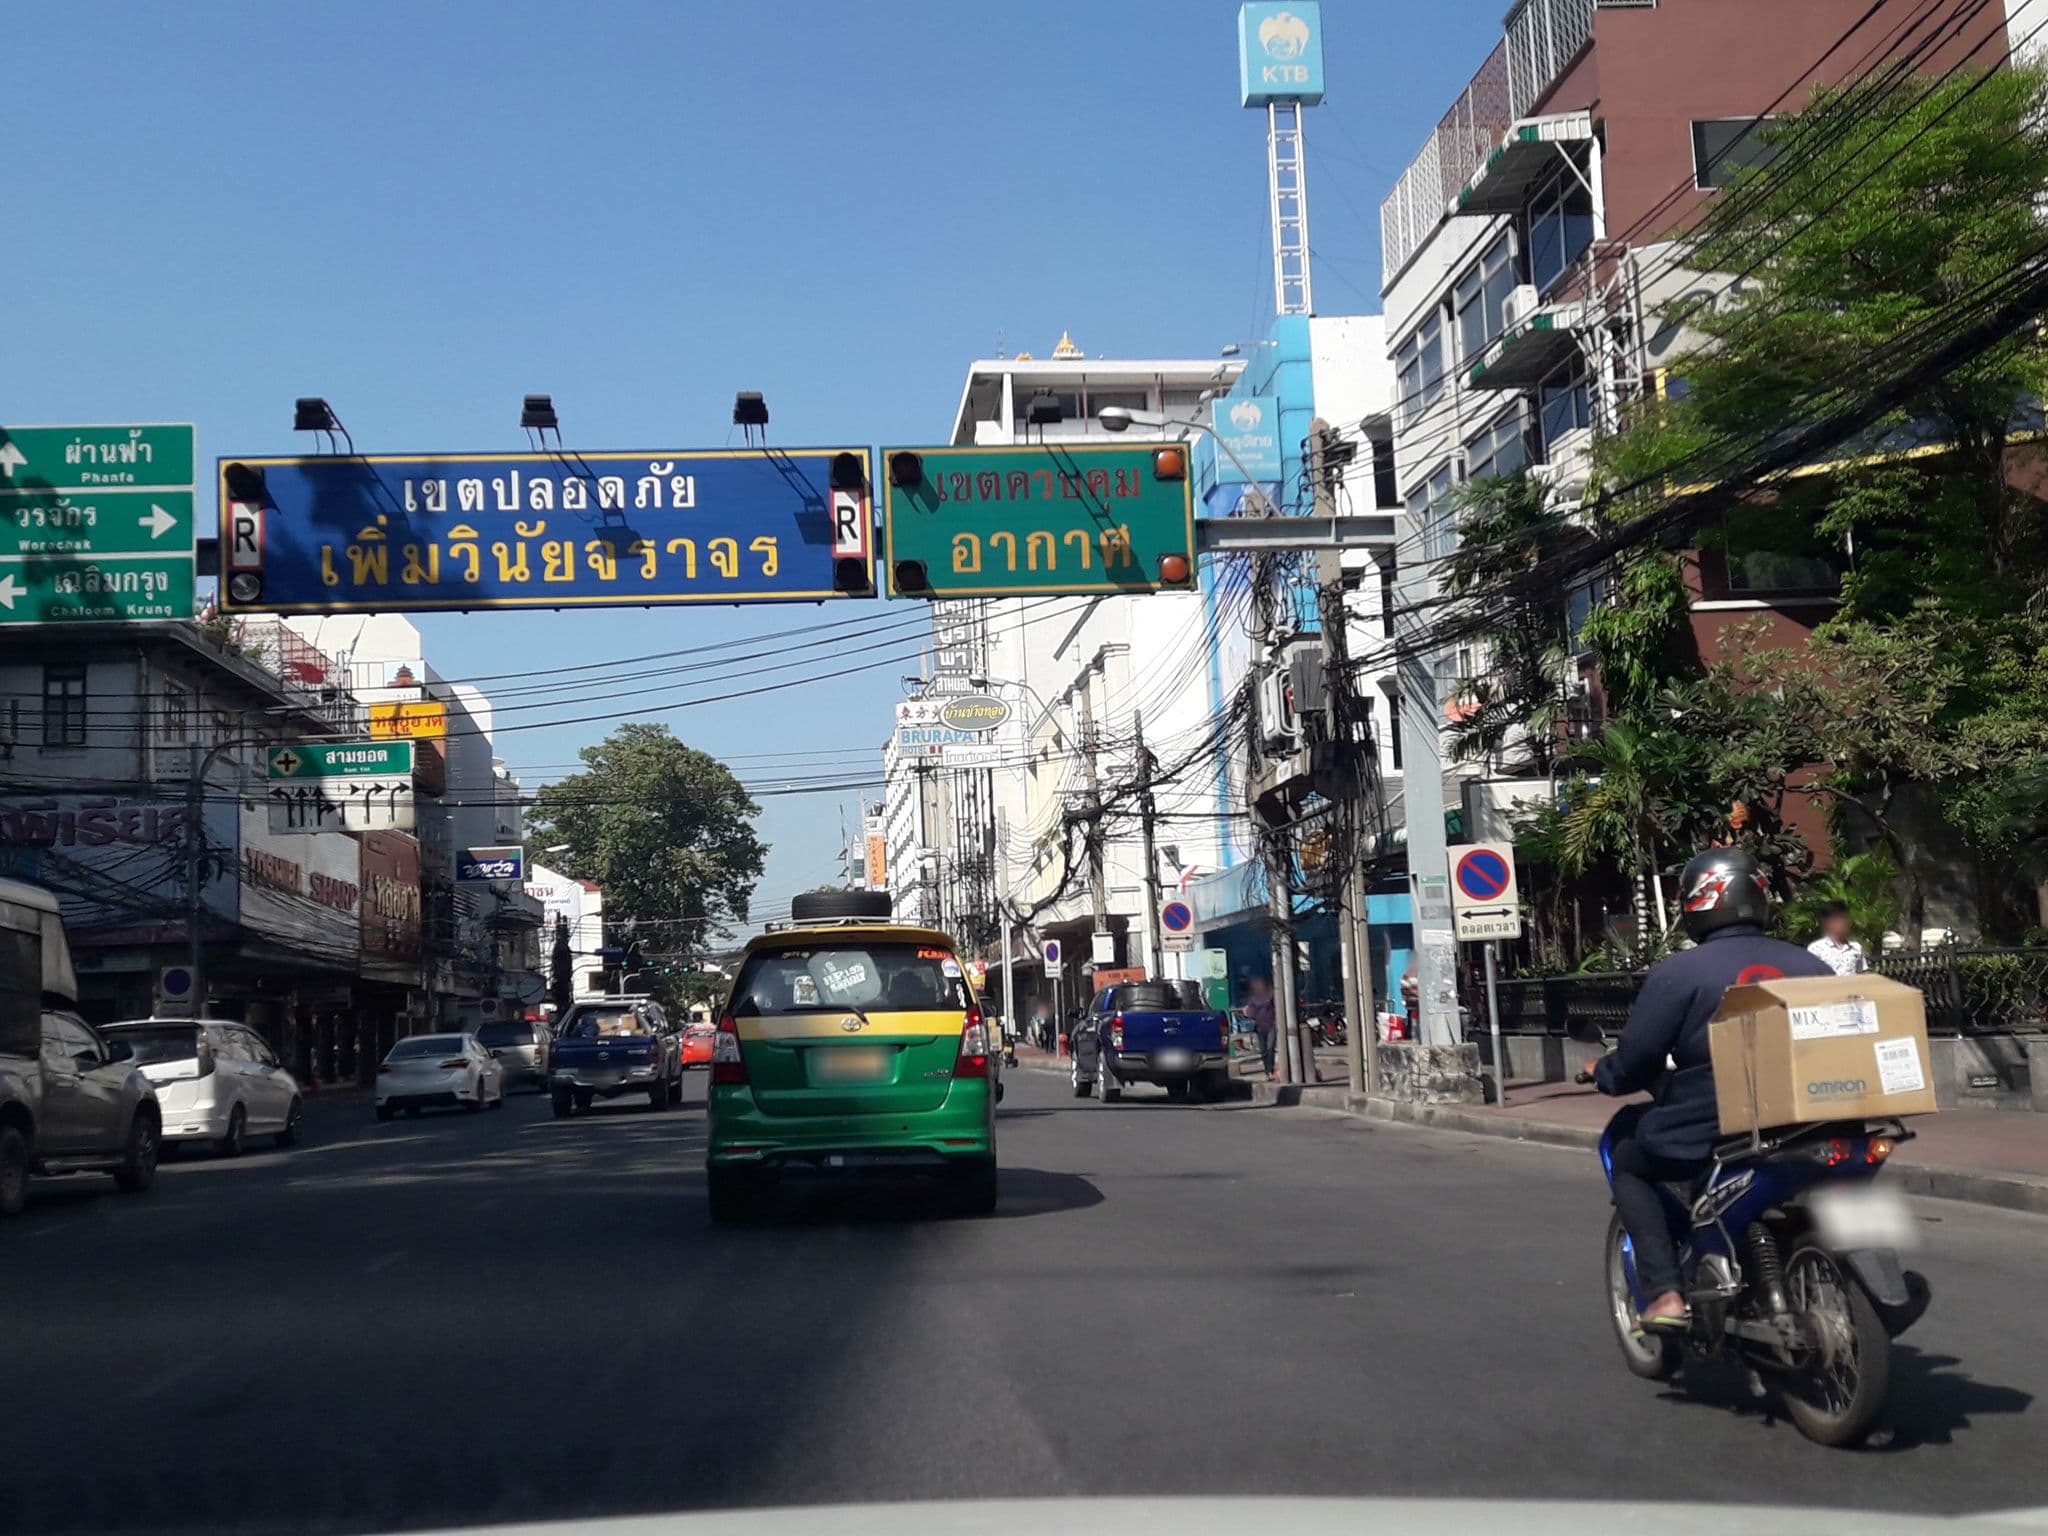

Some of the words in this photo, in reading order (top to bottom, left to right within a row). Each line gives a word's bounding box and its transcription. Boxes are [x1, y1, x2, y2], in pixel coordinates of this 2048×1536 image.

[1263, 65, 1309, 82] KTB
[65, 429, 153, 464] ผ่านฟ้า
[81, 472, 135, 483] Phanfa
[404, 462, 697, 512] เขตปลอดภัย
[937, 467, 1141, 514] เขตควบคุม
[15, 498, 97, 527] วรจักร
[836, 505, 859, 540] R
[234, 516, 257, 553] R
[322, 514, 779, 586] เพิ่มวินัยจราจร
[952, 523, 1131, 573] อากาศ
[55, 565, 169, 600] เฉลิมกรุง
[127, 604, 173, 617] Krung
[902, 729, 973, 744] BRURAPA
[325, 749, 389, 765] สามยอด
[310, 871, 358, 910] SHARP
[1461, 922, 1517, 934] ตลอดเวลา
[1792, 1010, 1820, 1025] MIX
